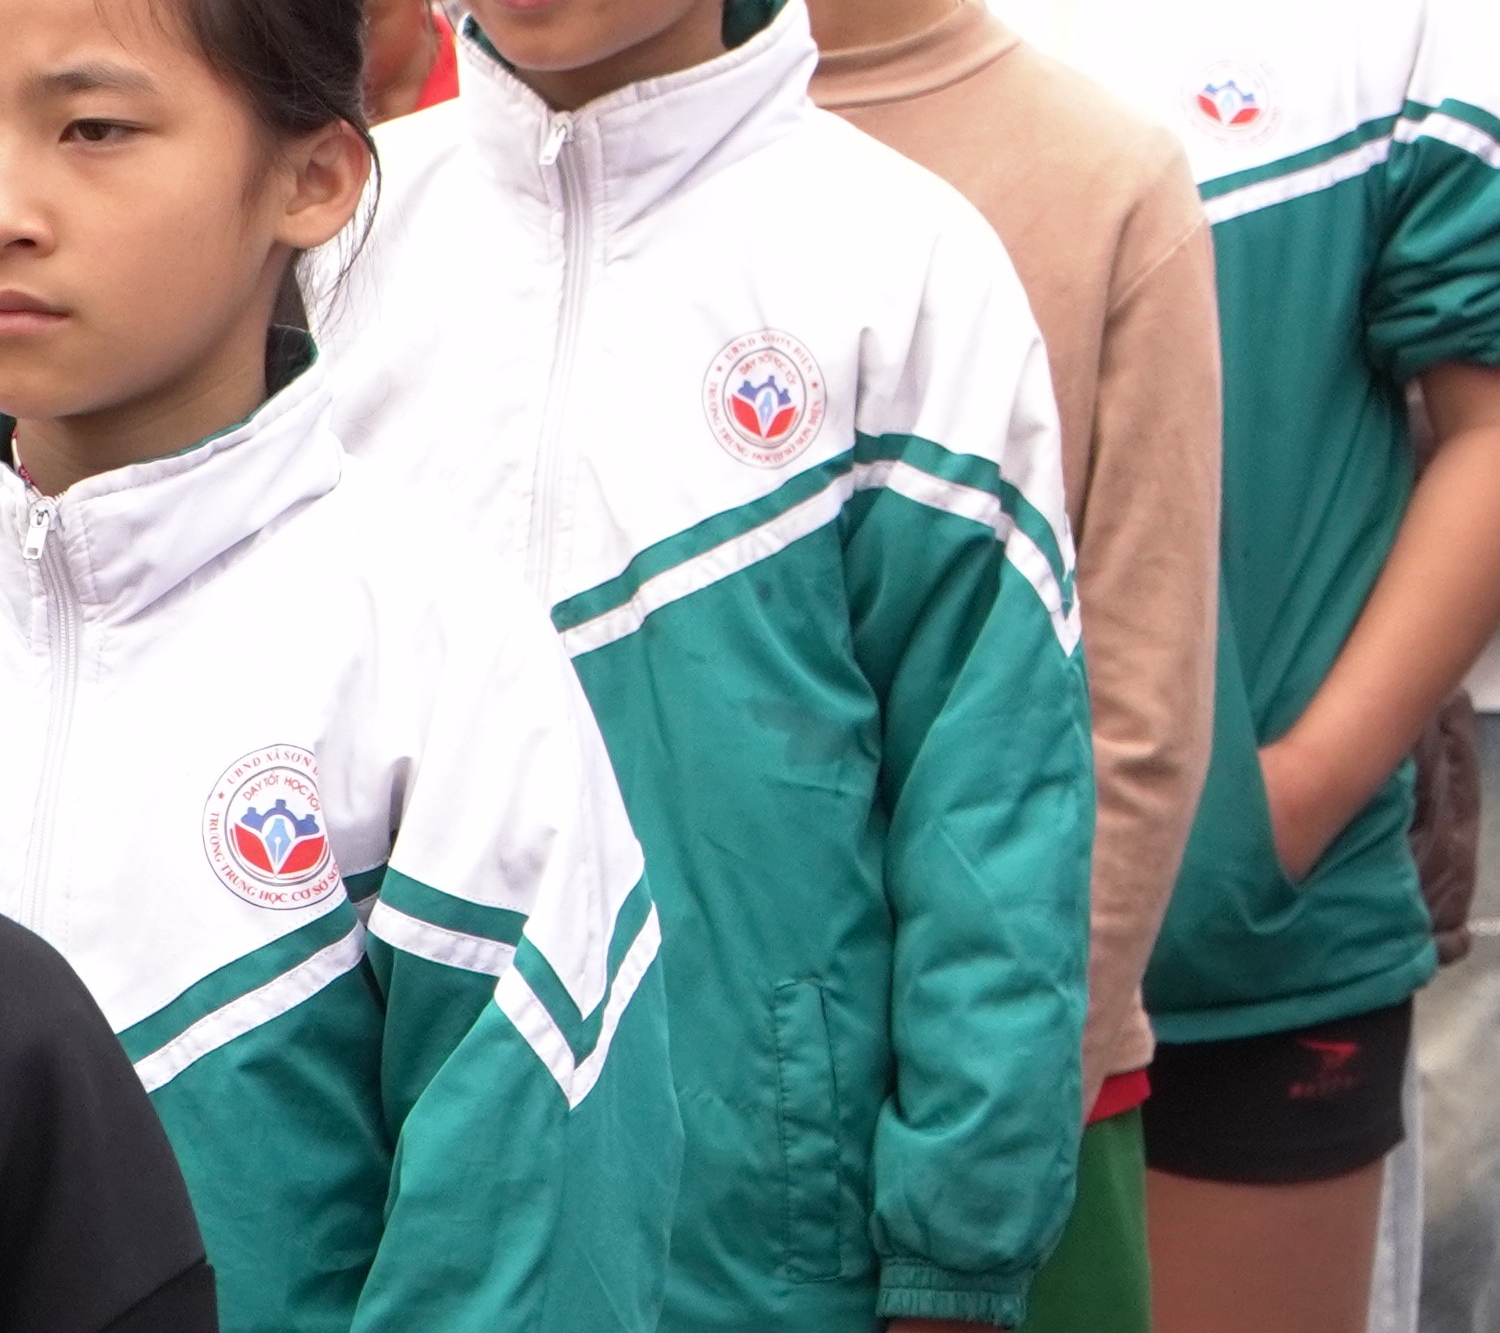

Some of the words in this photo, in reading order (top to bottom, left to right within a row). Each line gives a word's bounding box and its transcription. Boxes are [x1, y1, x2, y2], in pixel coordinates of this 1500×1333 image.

[227, 756, 261, 785] UBND
[283, 749, 312, 767] SƠN
[242, 781, 263, 801] DẠY
[263, 769, 280, 786] TỐT
[284, 775, 309, 796] HỌC
[209, 812, 221, 862] TRƯỜNG
[221, 862, 257, 896] TRUNG
[259, 892, 288, 904] HỌC
[291, 889, 312, 902] CƠ
